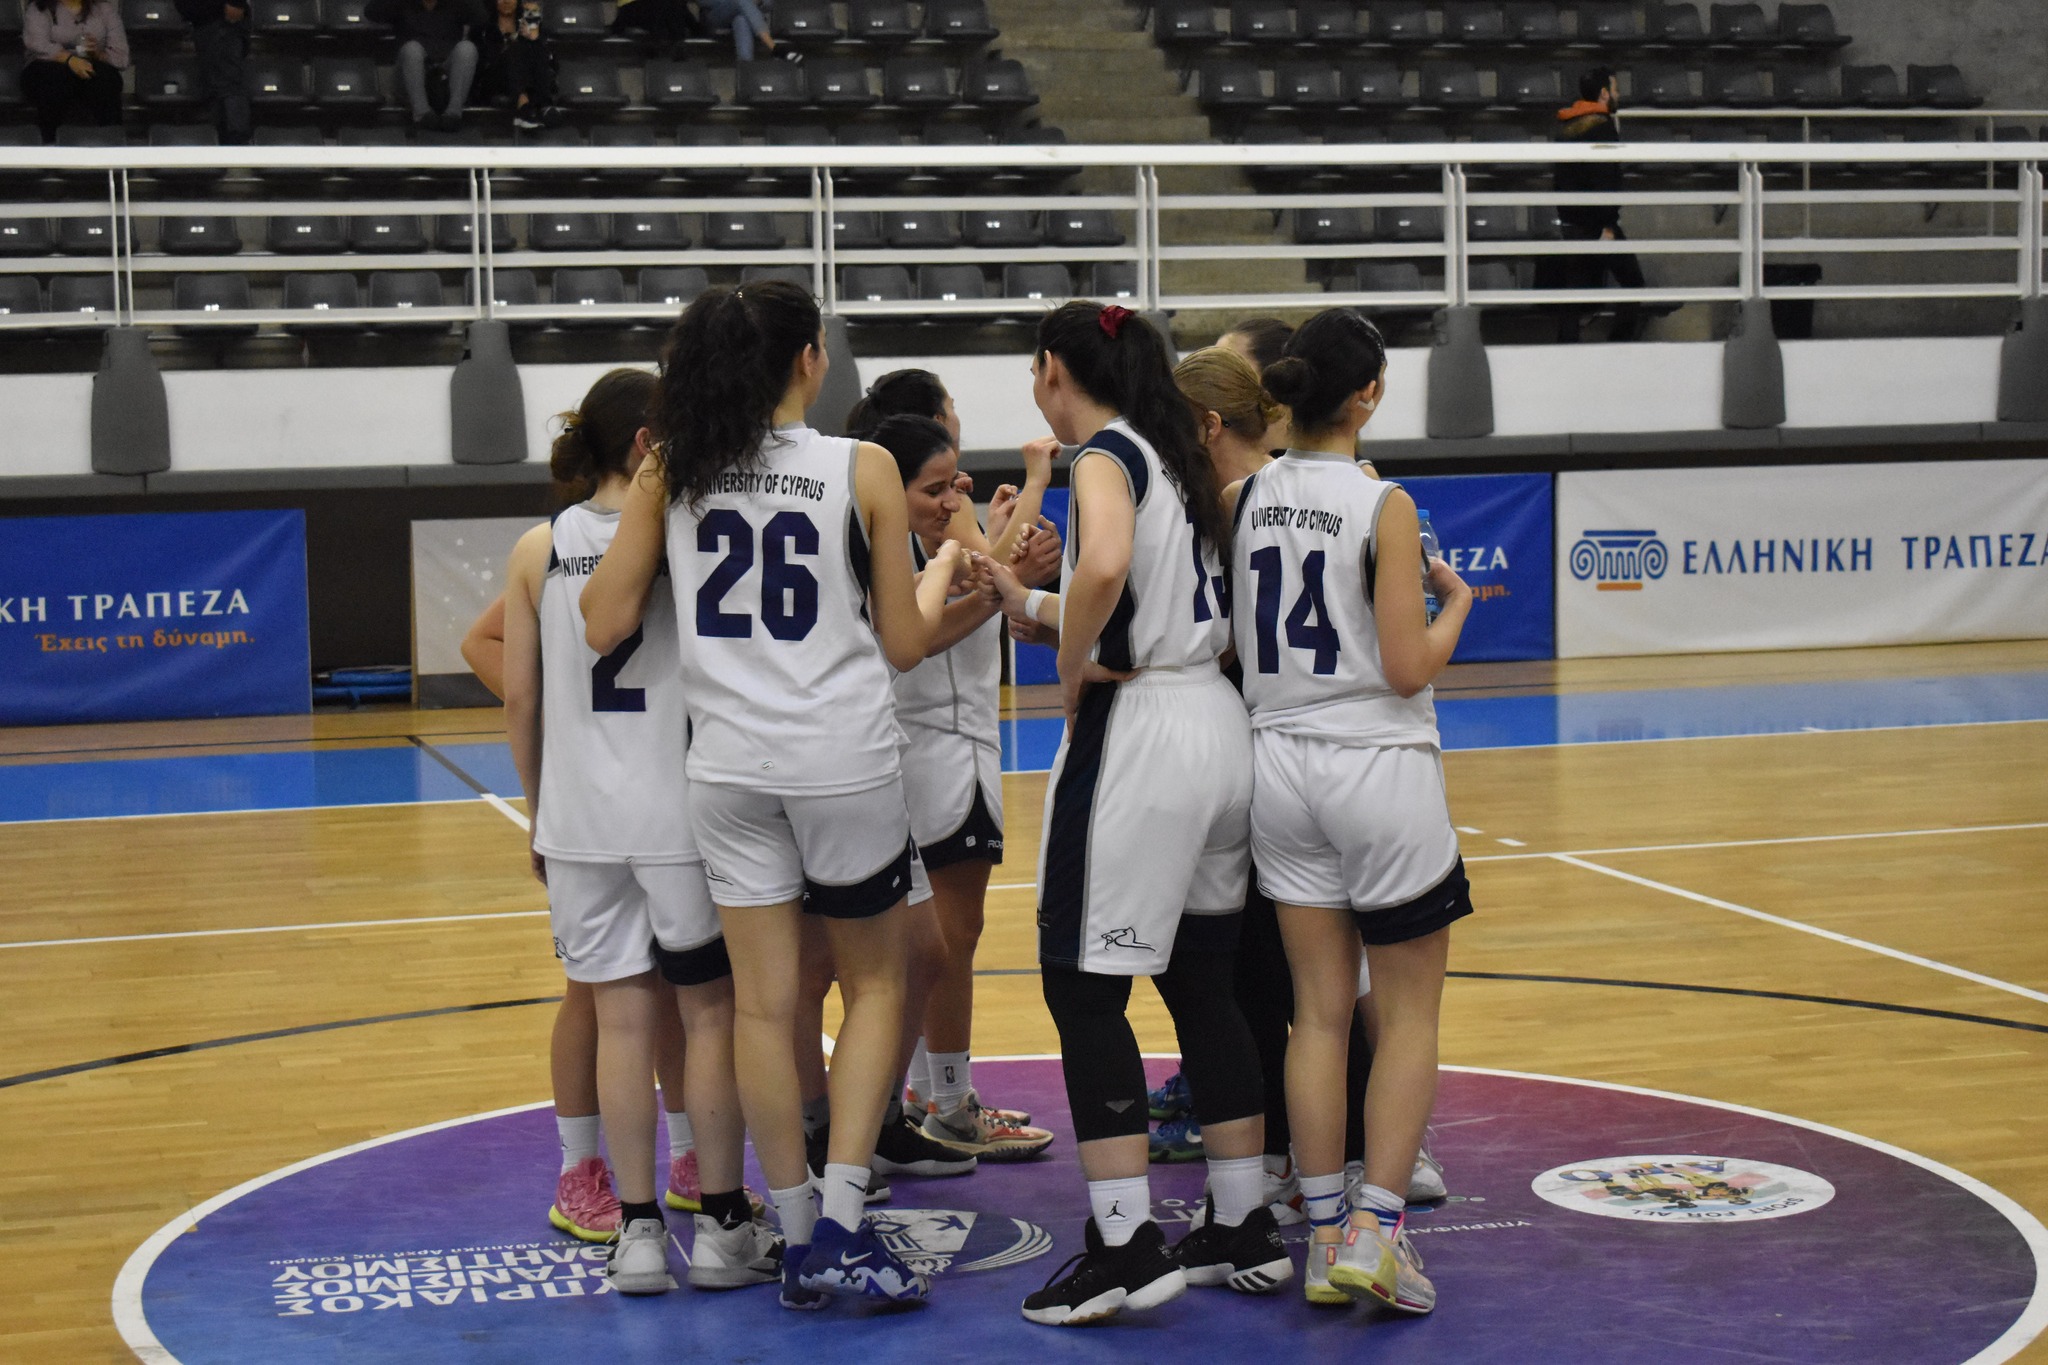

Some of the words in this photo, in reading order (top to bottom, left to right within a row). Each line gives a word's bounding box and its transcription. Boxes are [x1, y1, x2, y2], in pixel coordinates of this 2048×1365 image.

[702, 472, 763, 496] NIVERSITY
[764, 473, 780, 494] OF
[781, 474, 825, 502] CYPRUS
[1296, 508, 1309, 529] OF
[1309, 509, 1343, 537] CYPRUS
[1682, 536, 1874, 576] ΕΛΛΗΝΙΚΗ
[696, 508, 820, 642] 26
[67, 588, 250, 621] ΤΡΑΠΕΖΑ
[1249, 545, 1342, 675] 14
[34, 633, 108, 653] Έχεις
[117, 633, 145, 649] τη
[152, 627, 256, 652] δύναμη.
[591, 622, 646, 712] 2
[1630, 1208, 1671, 1217] ALL
[1686, 1209, 1736, 1218] FOR
[1749, 1196, 1805, 1214] SPORT
[272, 1245, 615, 1282] ΘΛΗΤΙΣΜΟΥ
[275, 1274, 679, 1317] ΥΠΡΙΑΚΟΣ
